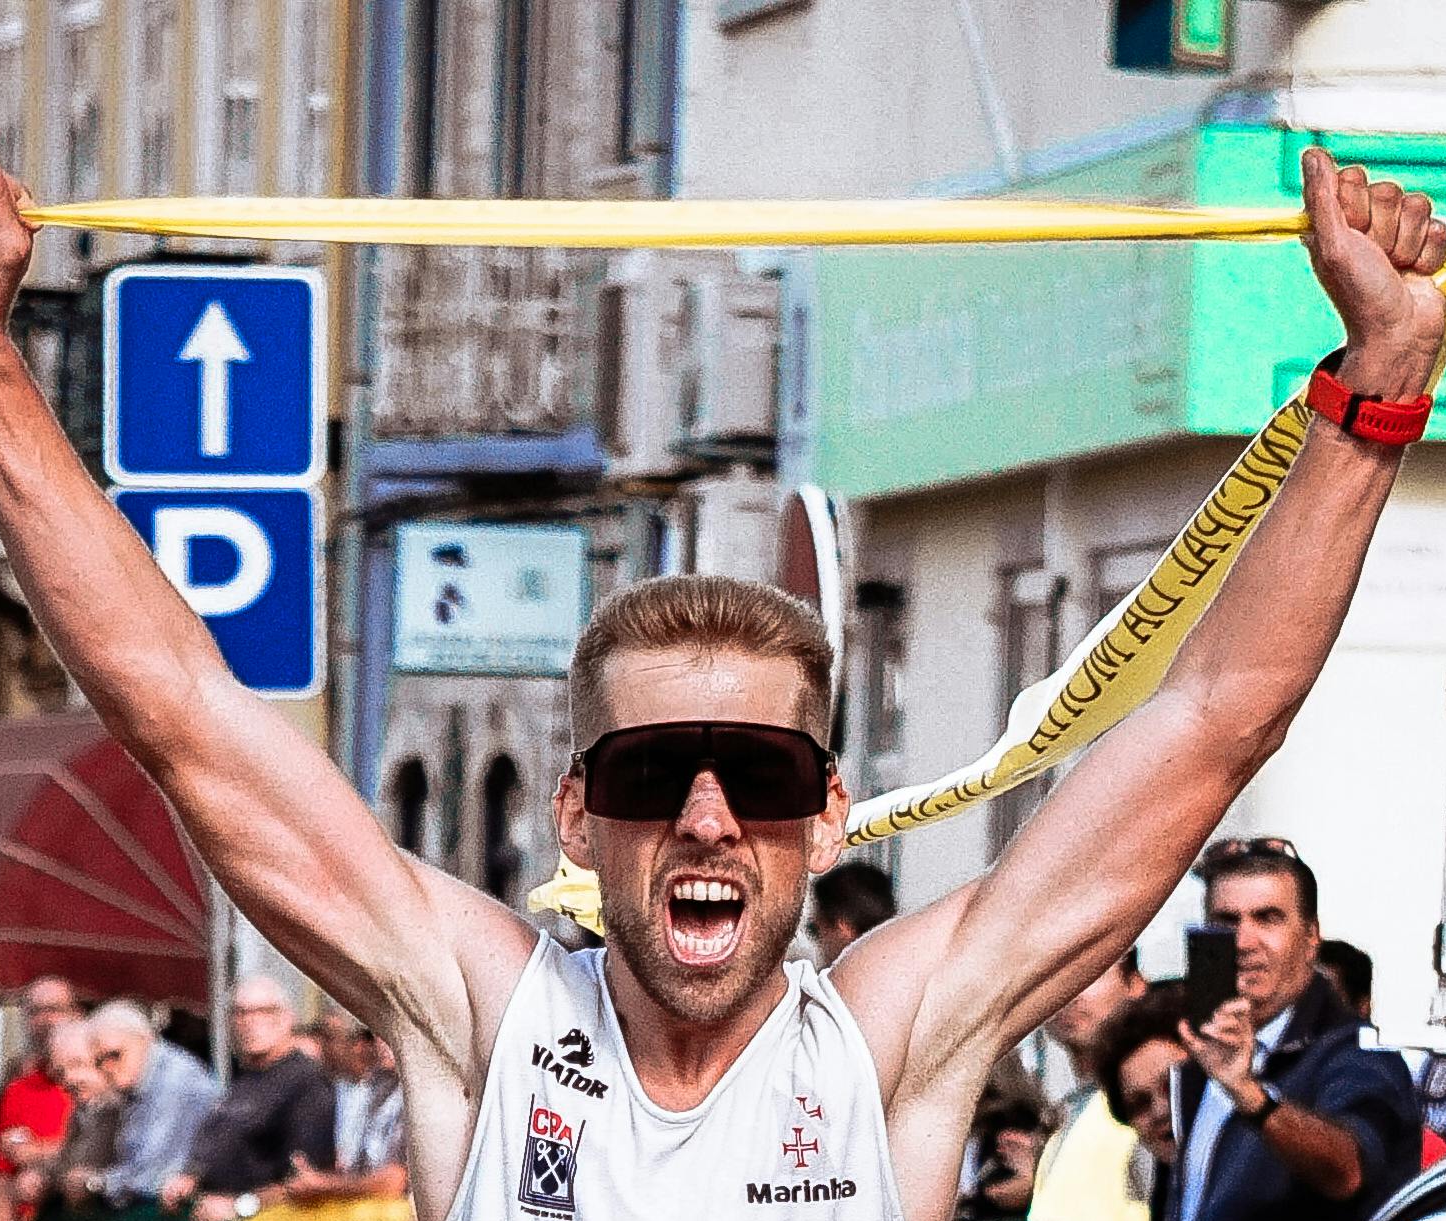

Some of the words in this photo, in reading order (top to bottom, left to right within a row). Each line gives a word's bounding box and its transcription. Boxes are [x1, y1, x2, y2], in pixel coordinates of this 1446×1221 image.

[153, 506, 277, 619] P
[531, 1043, 609, 1100] VIATOR
[532, 1108, 574, 1149] CPA
[746, 1177, 857, 1205] Marinha
